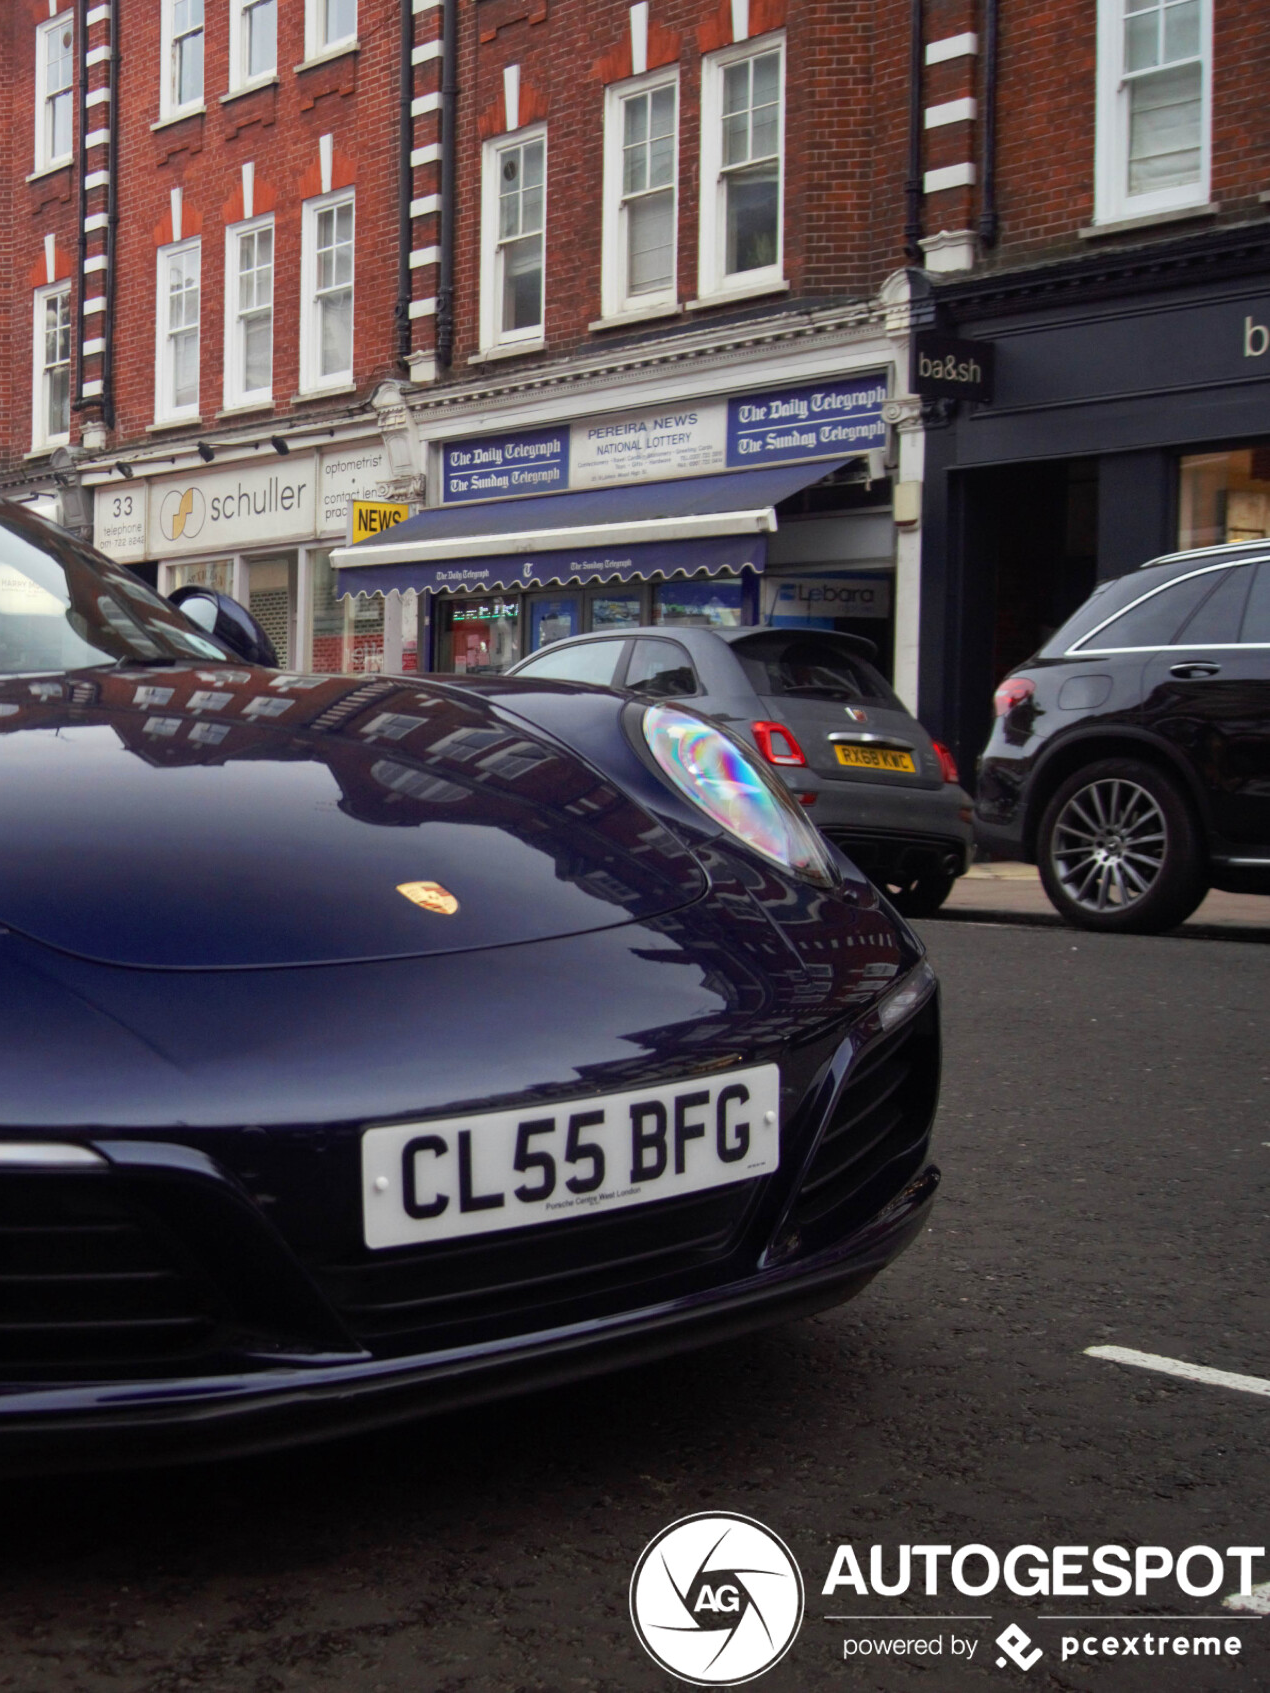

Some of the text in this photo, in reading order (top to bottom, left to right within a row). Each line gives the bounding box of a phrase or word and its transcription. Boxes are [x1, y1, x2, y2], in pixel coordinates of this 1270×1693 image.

[919, 352, 981, 383] ba&sh
[738, 386, 887, 423] The Daily Telegraph
[588, 413, 698, 440] PEREIRA NEWS
[738, 420, 886, 455] The Sunday Telegraph
[450, 439, 561, 467] The Daily Telegraph
[596, 432, 692, 456] NATIONAL LOTTERY
[325, 454, 383, 479] optometrist
[450, 467, 560, 493] The Sunday Telegraph
[113, 496, 133, 518] 33
[210, 477, 307, 522] schuller
[103, 522, 143, 538] telephone
[358, 508, 402, 532] NEWS
[436, 569, 490, 581] The Daily Telegraph
[570, 558, 632, 571] The Sunday Telegraph
[799, 583, 875, 602] Lebara
[841, 747, 880, 766] RX68
[401, 1083, 751, 1220] CL55 BFG
[545, 1199, 574, 1211] Porsche
[575, 1195, 598, 1206] Centre
[598, 1191, 616, 1201] West
[616, 1186, 642, 1198] London
